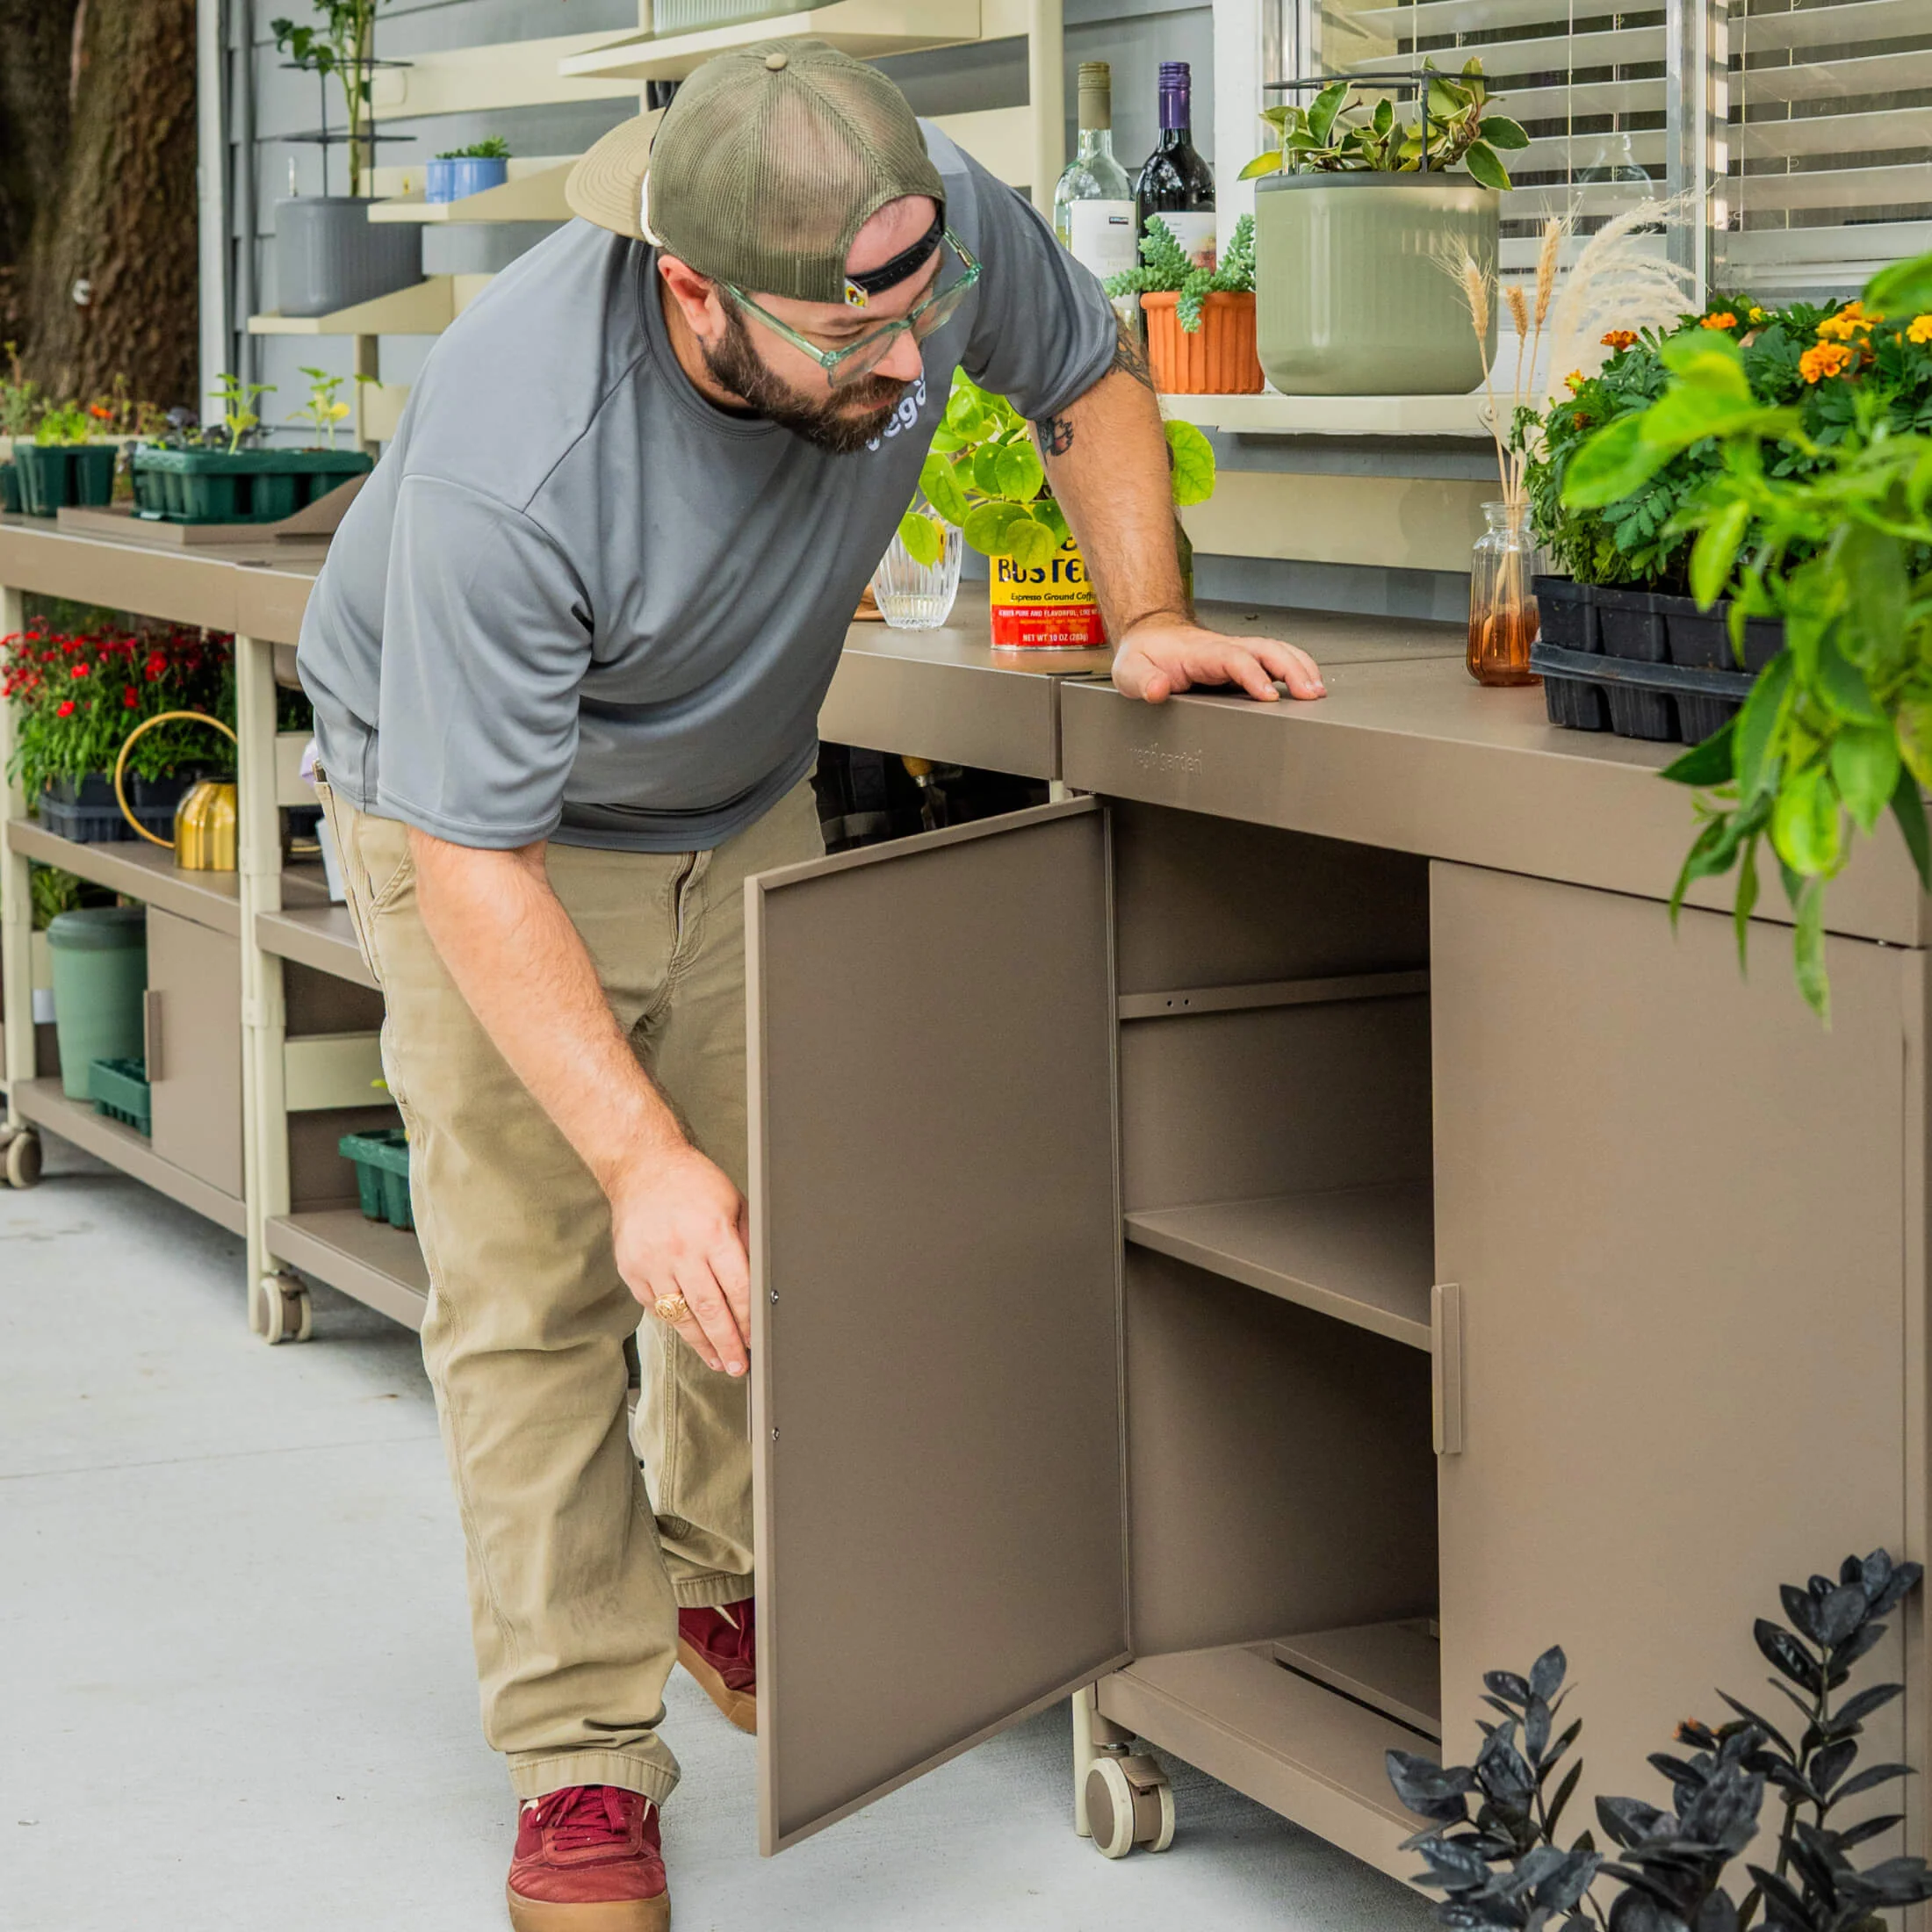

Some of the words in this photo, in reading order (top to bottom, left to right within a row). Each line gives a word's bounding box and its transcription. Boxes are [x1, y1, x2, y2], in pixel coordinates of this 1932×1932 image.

[998, 559, 1091, 583] BUSTE
[1011, 593, 1042, 602] Espresso
[1043, 592, 1075, 601] Ground
[1022, 633, 1035, 642] NET
[1037, 633, 1048, 642] WT
[1049, 633, 1057, 642] 10
[1059, 633, 1069, 642] OZ
